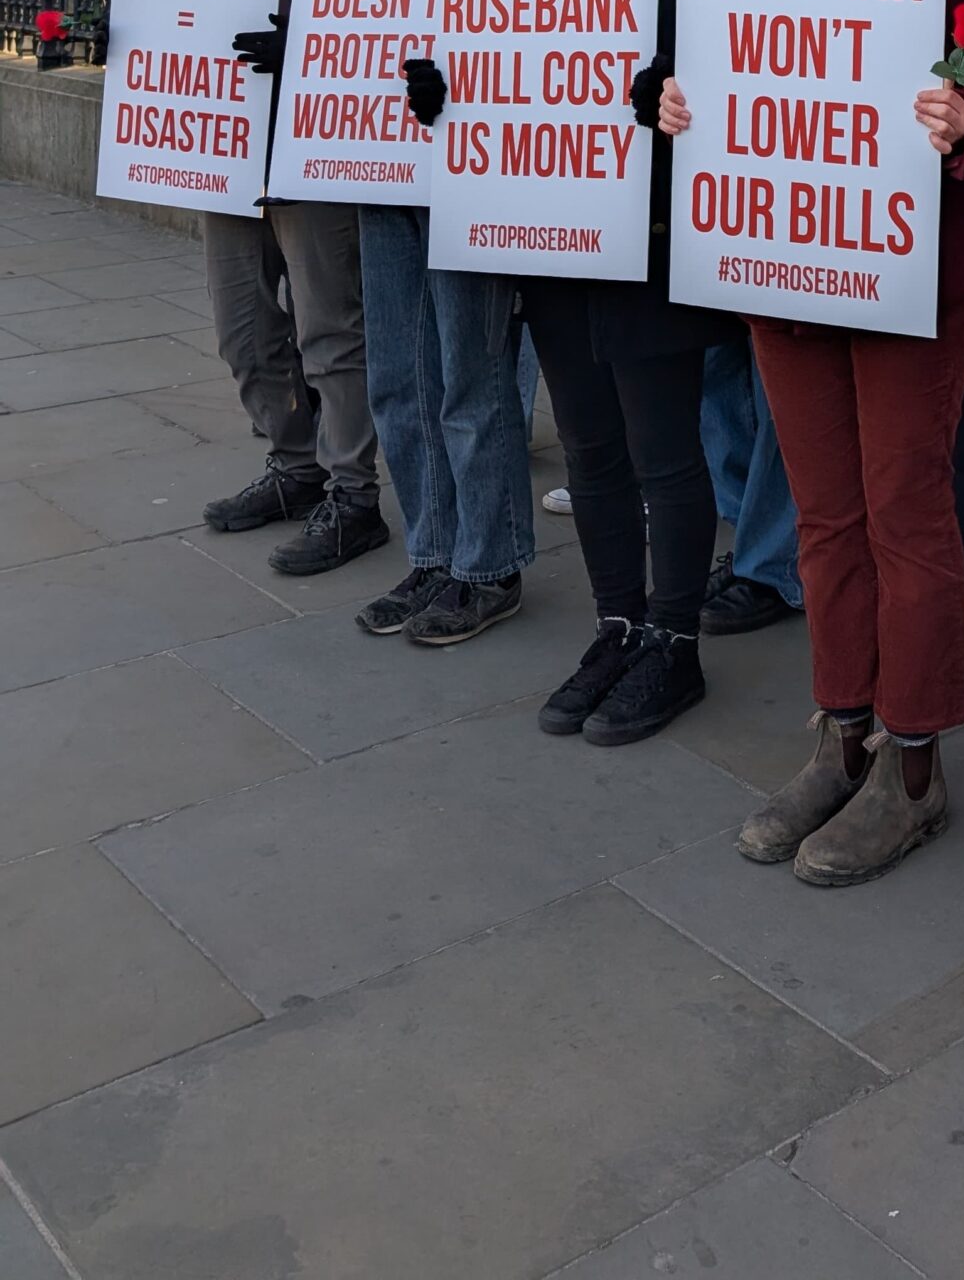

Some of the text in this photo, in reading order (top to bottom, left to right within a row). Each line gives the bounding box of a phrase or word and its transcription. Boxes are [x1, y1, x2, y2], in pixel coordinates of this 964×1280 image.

[728, 12, 872, 82] WON'T
[126, 49, 248, 103] CLIMATE
[448, 51, 640, 106] WILL COST
[115, 103, 250, 160] DISASTER
[293, 93, 433, 144] WORKER
[726, 94, 880, 168] LOWER
[303, 159, 416, 184] #STOPROSEBANK
[447, 121, 636, 180] US MONEY
[128, 163, 229, 194] #STOPROSEBANK
[468, 223, 602, 254] #STOPROSEBANK
[691, 172, 915, 256] OUR BILLS
[718, 256, 880, 302] #STOPROSEBANK
